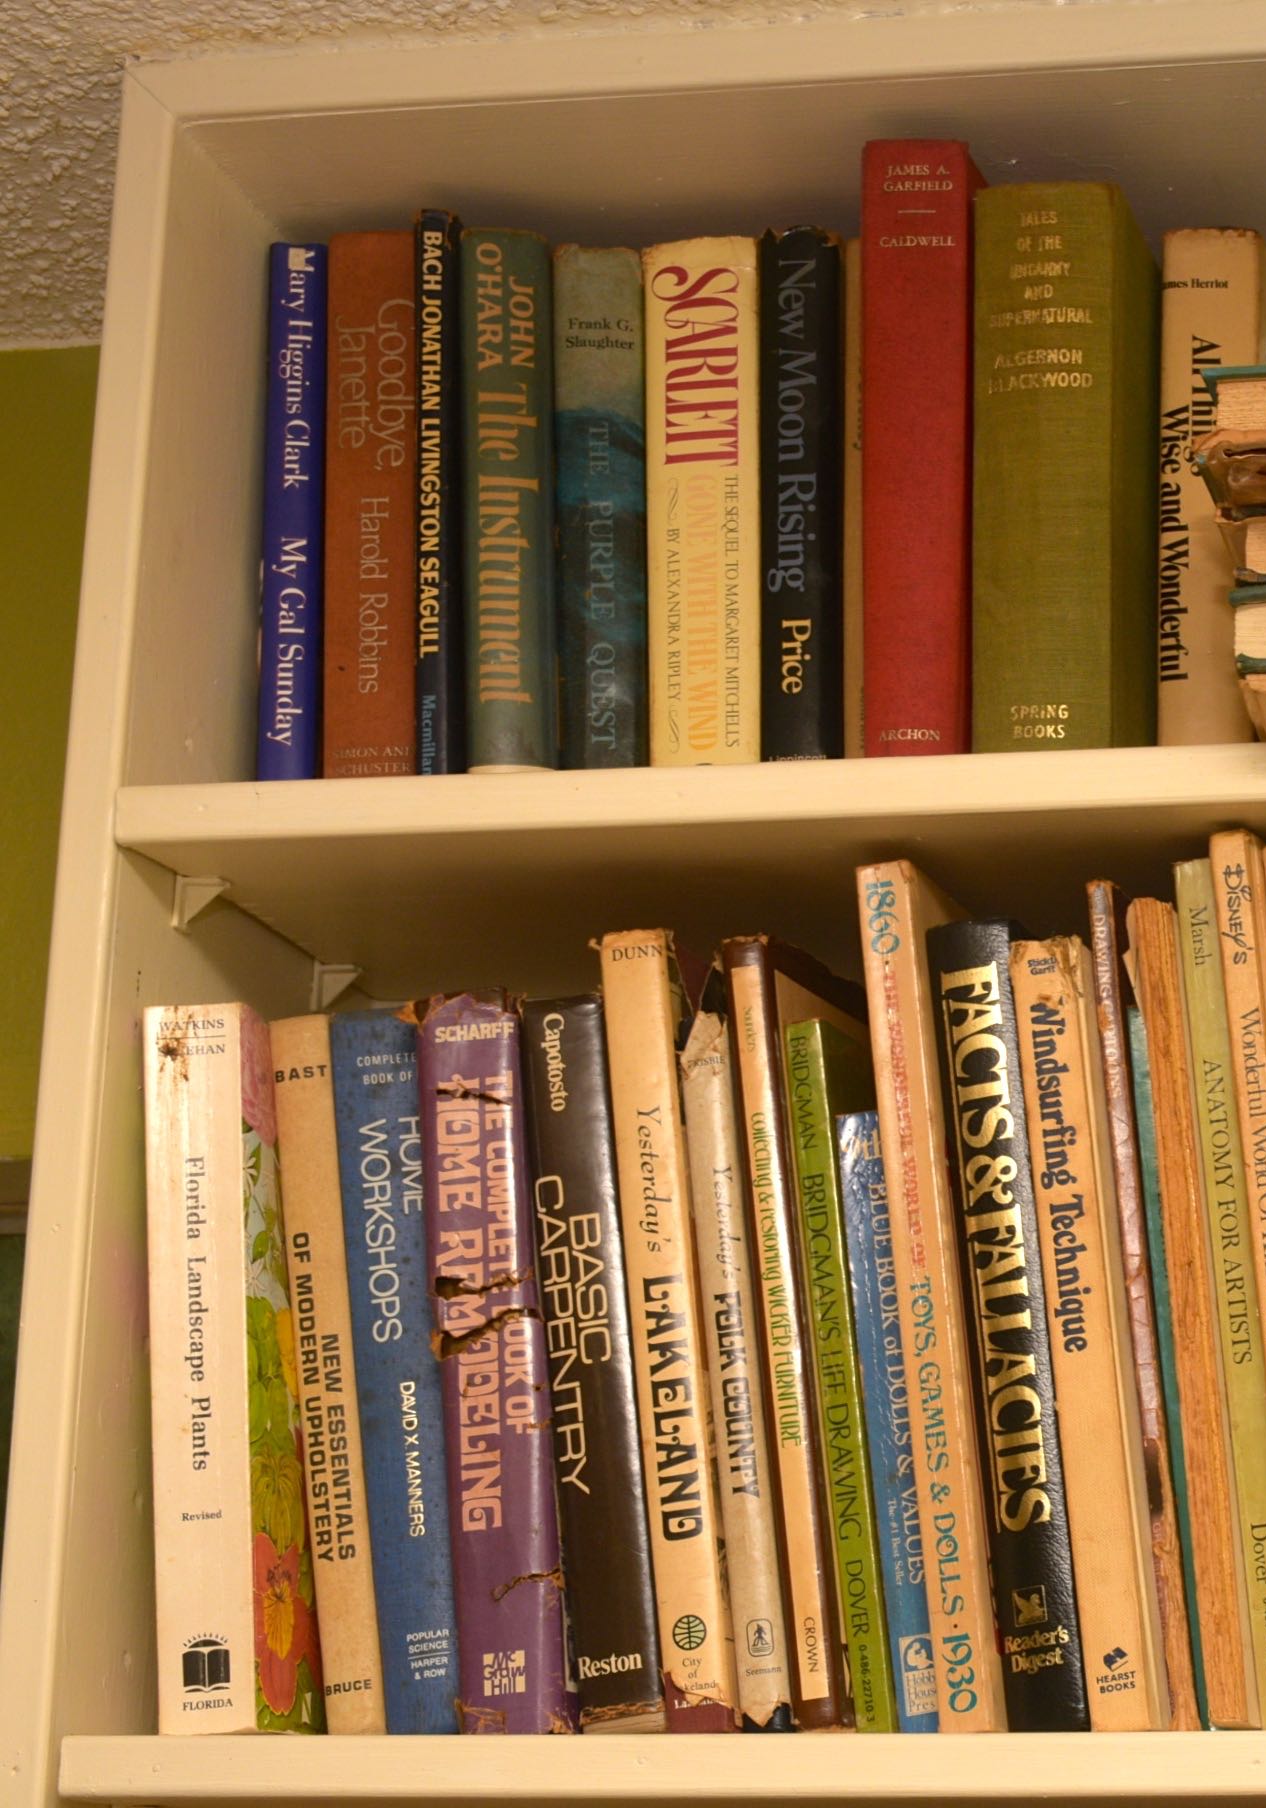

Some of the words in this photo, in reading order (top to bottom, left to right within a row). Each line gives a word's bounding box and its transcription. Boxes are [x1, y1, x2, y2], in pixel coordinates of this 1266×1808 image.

[884, 179, 953, 193] GARFIELD
[887, 164, 932, 177] JAMES
[423, 230, 443, 292] BACH
[879, 235, 957, 249] CALDWELL
[476, 241, 503, 372] O'HARA
[510, 276, 536, 368] JOHN
[776, 258, 819, 339] New
[1191, 278, 1229, 289] Herriot
[421, 295, 443, 411] JONATHAN
[566, 336, 635, 351] Slaughter
[568, 317, 611, 331] Frank
[279, 319, 314, 414] Higgins
[336, 315, 374, 449] Janette
[651, 265, 741, 467] SCARLETT
[478, 383, 538, 463] The
[777, 349, 819, 463] Moon
[1161, 404, 1190, 475] Wise
[282, 420, 312, 488] Clark
[420, 417, 442, 552] LIVINGSTON
[587, 421, 610, 475] THE
[686, 474, 718, 547] GONE
[724, 473, 741, 503] THE
[1160, 481, 1190, 533] and
[272, 537, 307, 578] My
[359, 496, 390, 580] Harold
[588, 499, 615, 618] PURPLE
[724, 505, 741, 557] SEQUEL
[767, 471, 818, 593] Rising
[276, 587, 311, 635] Gal
[419, 556, 440, 659] SEAGULL
[477, 474, 540, 704] Instrument
[666, 548, 682, 646] ALEXANDRA
[686, 550, 718, 620] WITH
[723, 583, 741, 662] MARGARET
[1158, 537, 1190, 683] Wonderful
[359, 591, 388, 694] Robbins
[666, 650, 682, 702] RIPLEY
[686, 623, 718, 677] THE
[780, 617, 815, 694] Price
[267, 641, 306, 746] Sunday
[588, 641, 616, 749] QUEST
[686, 680, 718, 751] WIND
[723, 665, 741, 748] MITCHELL'S
[1010, 704, 1069, 723] SPRING
[1013, 723, 1066, 740] BOOKS
[421, 694, 436, 776] Macmillan
[879, 728, 941, 743] ARCHON
[611, 943, 665, 963] DUNN
[865, 879, 901, 957] 1860
[1091, 914, 1114, 997] DRAWING
[1188, 906, 1214, 967] Marsh
[434, 1021, 515, 1044] SCHARFF
[542, 1011, 567, 1113] Capotosto
[275, 1063, 329, 1083] BAST
[362, 1071, 394, 1086] BOOK
[788, 1035, 817, 1151] BRIDGMAN
[1029, 998, 1078, 1191] Windsurfing
[434, 1074, 484, 1217] HOME
[750, 1111, 777, 1188] collecting
[1202, 1058, 1237, 1188] ANATOMY
[185, 1155, 207, 1240] Florida
[635, 1103, 672, 1254] Yesterday's
[867, 1181, 893, 1249] BLUE
[292, 1231, 312, 1264] OF
[359, 1117, 403, 1346] WORKSHOPS
[712, 1164, 743, 1284] Yesterday's
[760, 1207, 784, 1282] restoring
[802, 1171, 843, 1343] BRIDGMAN'S
[1217, 1200, 1241, 1250] FOR
[569, 1211, 613, 1366] BASIC
[874, 1253, 900, 1330] BOOK
[1049, 1193, 1093, 1355] Technique
[1222, 1256, 1253, 1366] ARTISTS
[185, 1254, 208, 1383] Landscape
[293, 1273, 322, 1387] MODERN
[533, 1174, 591, 1496] CARPENTRY
[767, 1283, 793, 1348] WICKER
[911, 1275, 938, 1359] TOYS,
[320, 1332, 344, 1394] NEW
[772, 1349, 803, 1449] FURNITURE
[820, 1349, 847, 1397] LIFE
[886, 1351, 914, 1446] DOLLS
[190, 1396, 212, 1473] Plants
[400, 1381, 418, 1431] DAVID
[642, 1271, 704, 1543] LAKELAND
[720, 1377, 761, 1501] COUNTY
[917, 1362, 950, 1474] GAMES
[303, 1394, 334, 1564] UPHOLSTERY
[325, 1401, 356, 1562] ESSENTIALS
[405, 1449, 427, 1538] MANNERS
[826, 1402, 862, 1542] DRAWING
[930, 1480, 952, 1506] &
[182, 1509, 222, 1522] Revised
[844, 1559, 871, 1638] DOVER
[932, 1510, 965, 1616] DOLLS
[407, 1629, 450, 1642] POPULAR
[408, 1640, 449, 1653] SCIENCE
[411, 1655, 449, 1669] HARPER
[422, 1667, 447, 1680] ROW
[577, 1651, 644, 1681] Reston
[803, 1615, 820, 1673] CROWN
[941, 1631, 979, 1714] 1930
[1003, 1624, 1070, 1655] Reader's
[1010, 1647, 1064, 1676] Digest
[182, 1696, 234, 1712] FLORIDA
[326, 1678, 373, 1697] BRUCE
[1096, 1671, 1137, 1686] HEARST
[1099, 1681, 1137, 1695] BOOKS
